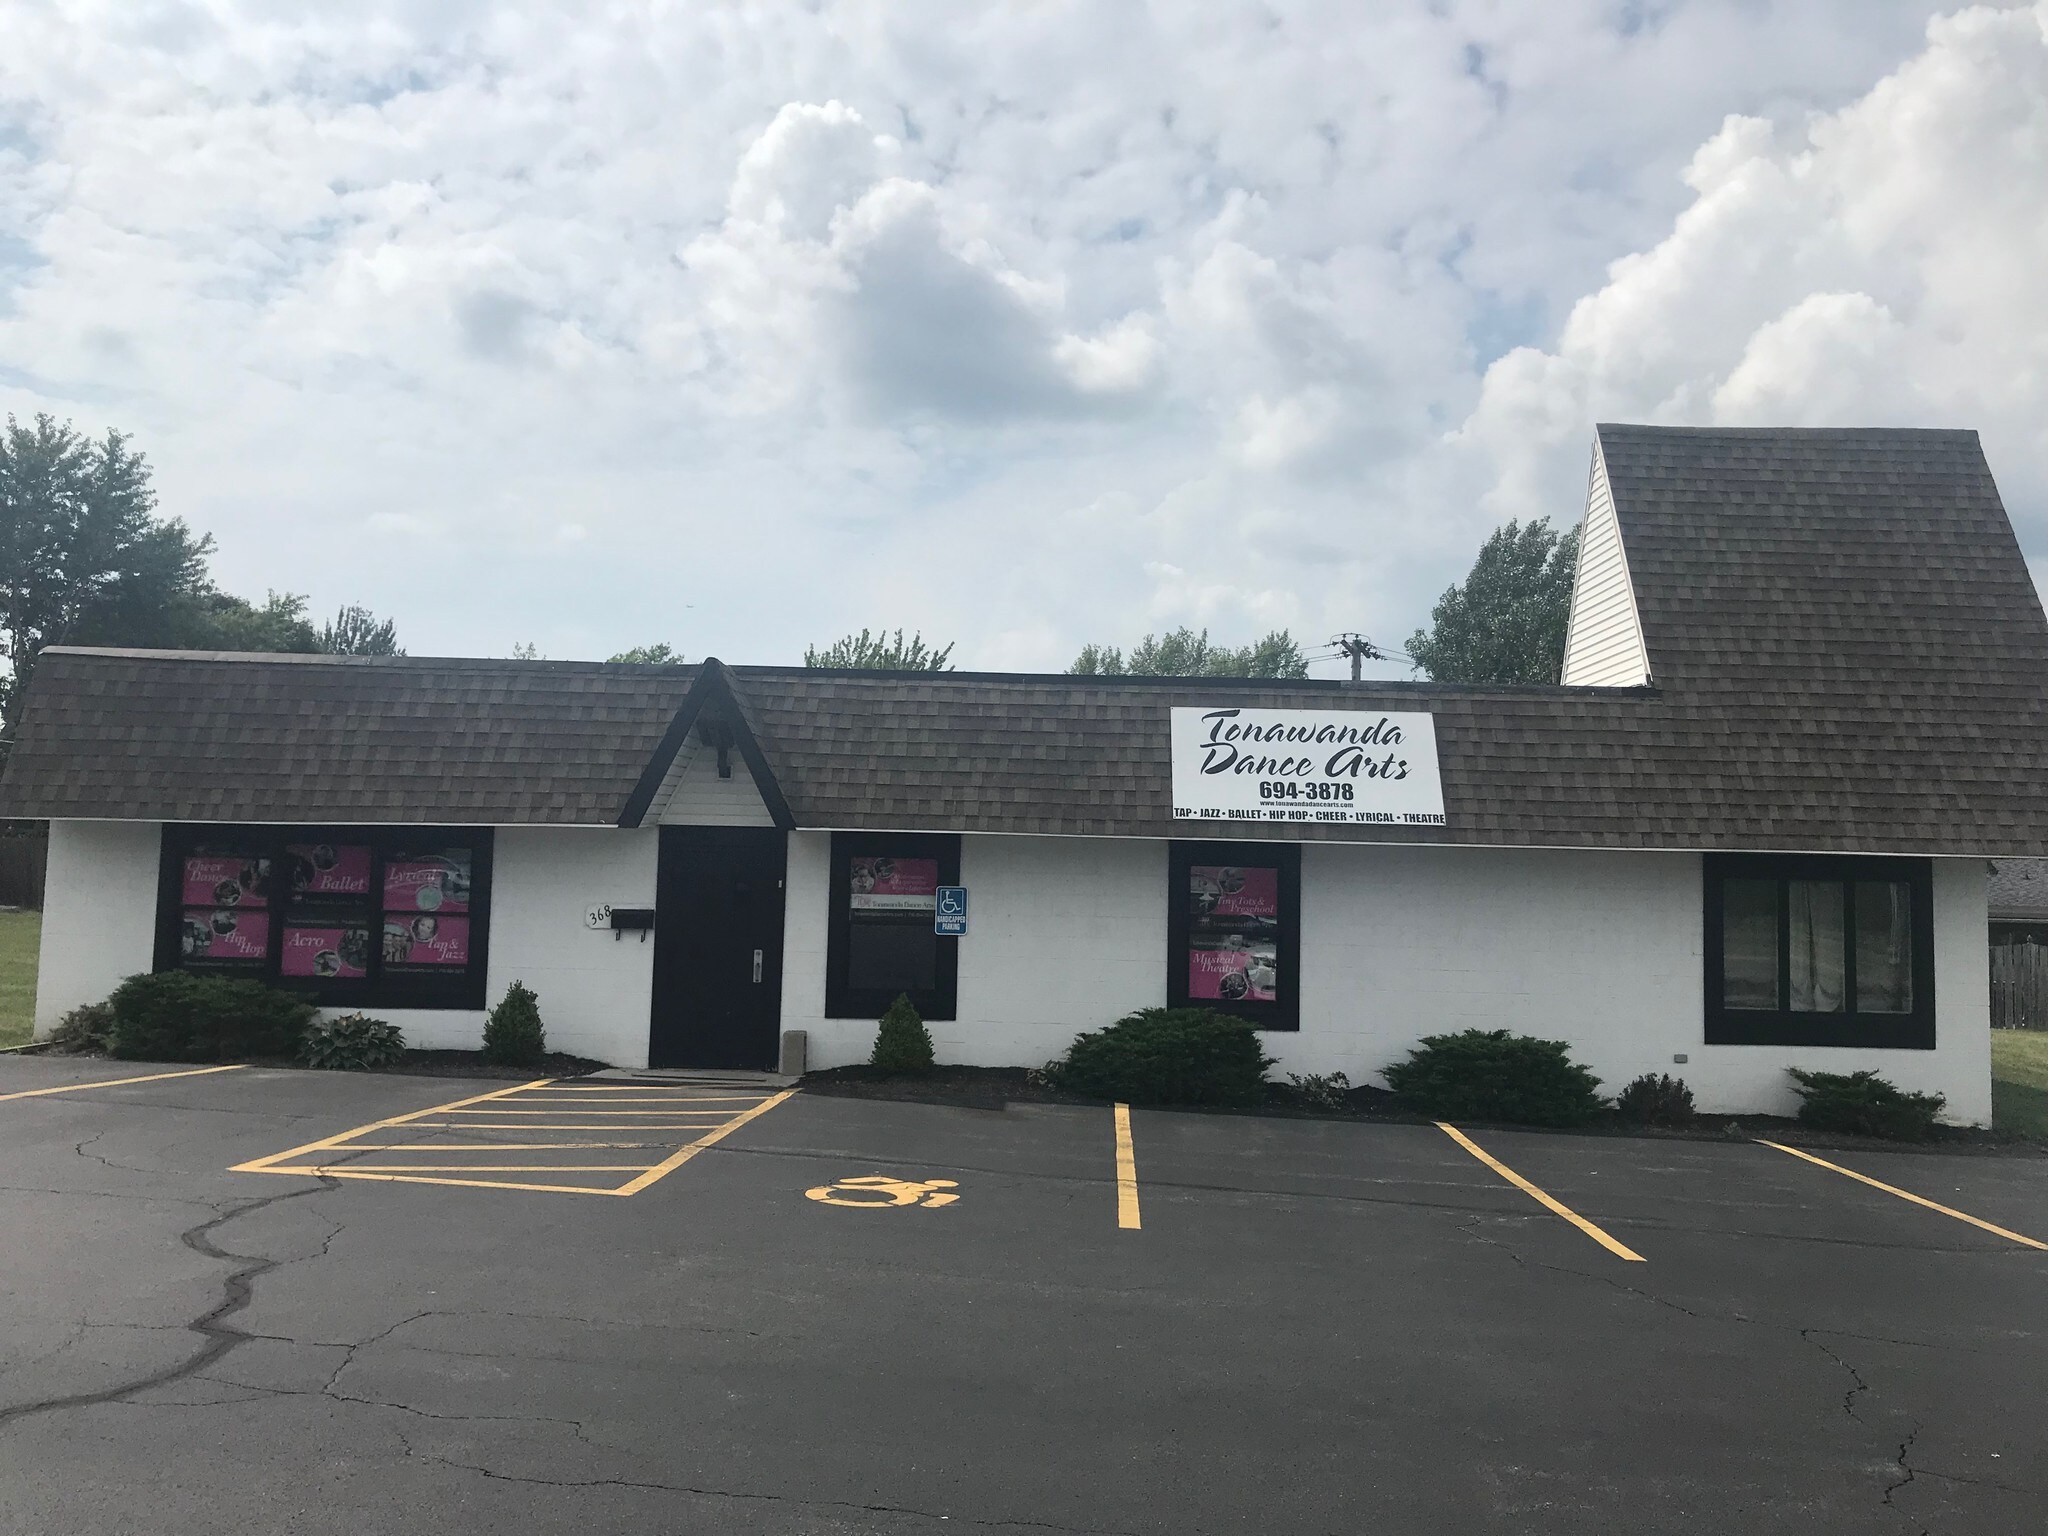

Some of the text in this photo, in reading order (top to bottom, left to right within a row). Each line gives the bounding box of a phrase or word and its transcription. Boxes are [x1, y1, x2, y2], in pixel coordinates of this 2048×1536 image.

[1202, 709, 1406, 746] Tonawanda
[1200, 742, 1412, 780] Dance Arts
[1259, 781, 1354, 801] 694-3878
[1260, 801, 1354, 809] www.tonawandadancearts.com
[1174, 808, 1445, 824] TAP JAZZ BALLET HIP HOP CHEER LYRICAL THEATRE
[320, 875, 364, 890] Ballet
[589, 904, 612, 925] 368
[1230, 902, 1274, 914] Preschool
[937, 915, 966, 923] HANDICAPPED
[942, 923, 960, 931] PARKING
[224, 932, 246, 947] Hip
[288, 932, 325, 947] Acro
[240, 942, 265, 957] Hop
[437, 947, 466, 961] Jazz
[1193, 953, 1235, 965] Musical
[1201, 963, 1240, 974] Theatre
